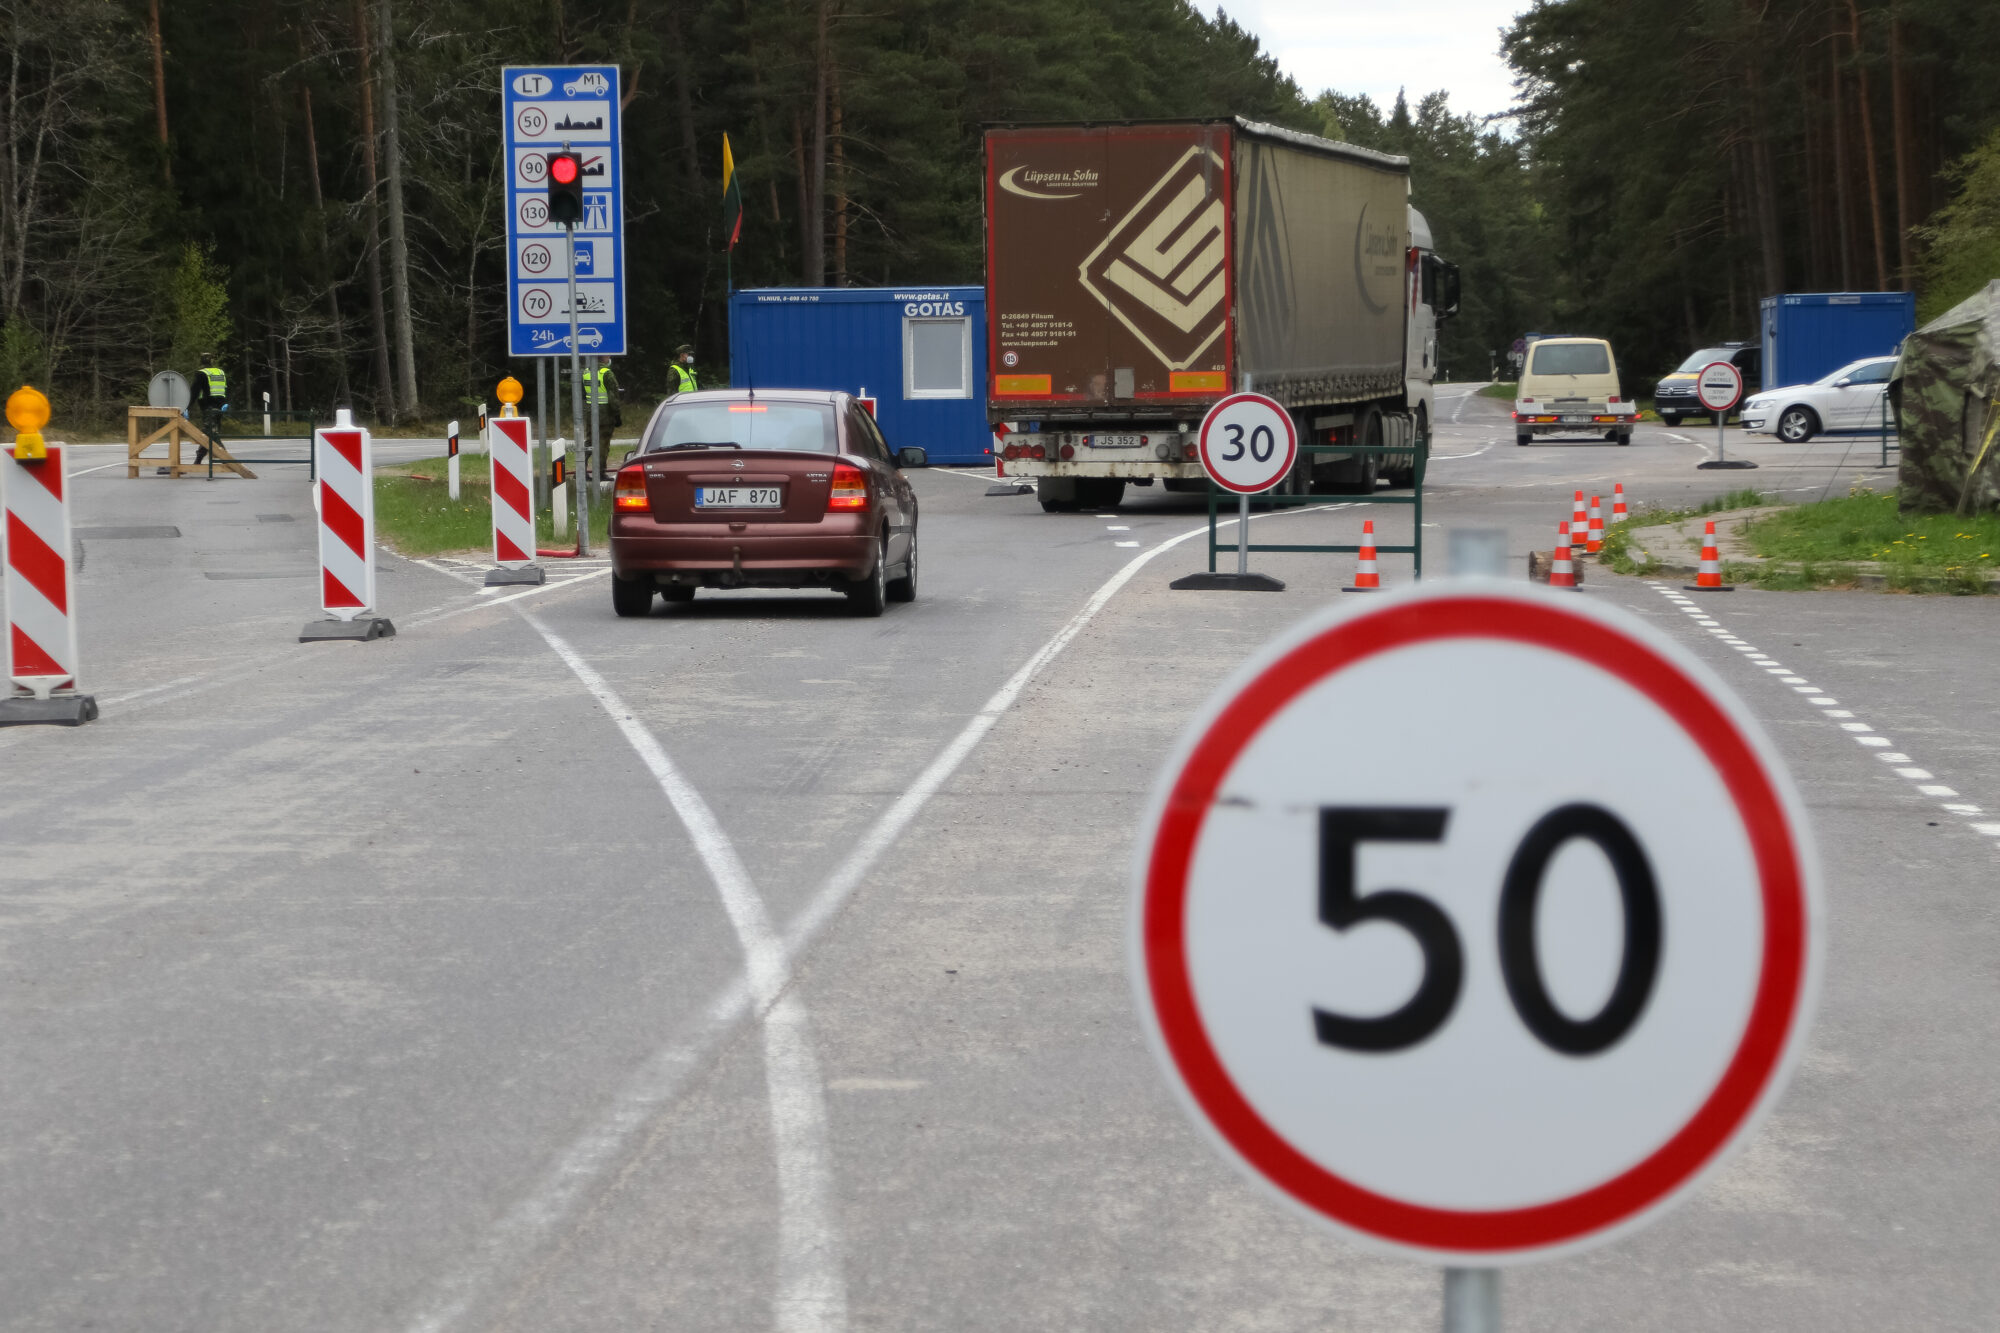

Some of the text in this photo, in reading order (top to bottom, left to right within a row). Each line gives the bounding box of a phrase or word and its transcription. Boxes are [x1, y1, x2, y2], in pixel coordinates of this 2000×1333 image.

[522, 77, 542, 93] LT
[583, 74, 602, 86] M1
[524, 116, 542, 128] 50
[526, 162, 543, 174] 90
[1024, 168, 1098, 184] Lüpsen u. Sohn
[524, 208, 546, 220] 130
[526, 252, 548, 264] 120
[894, 292, 949, 302] www.gotas.lt
[529, 298, 546, 310] 70
[904, 302, 964, 316] GOTAS
[532, 330, 554, 342] 24h
[1100, 436, 1134, 445] JS 352
[1222, 424, 1274, 463] 30
[706, 490, 778, 503] JAF 870
[1311, 802, 1665, 1058] 50
